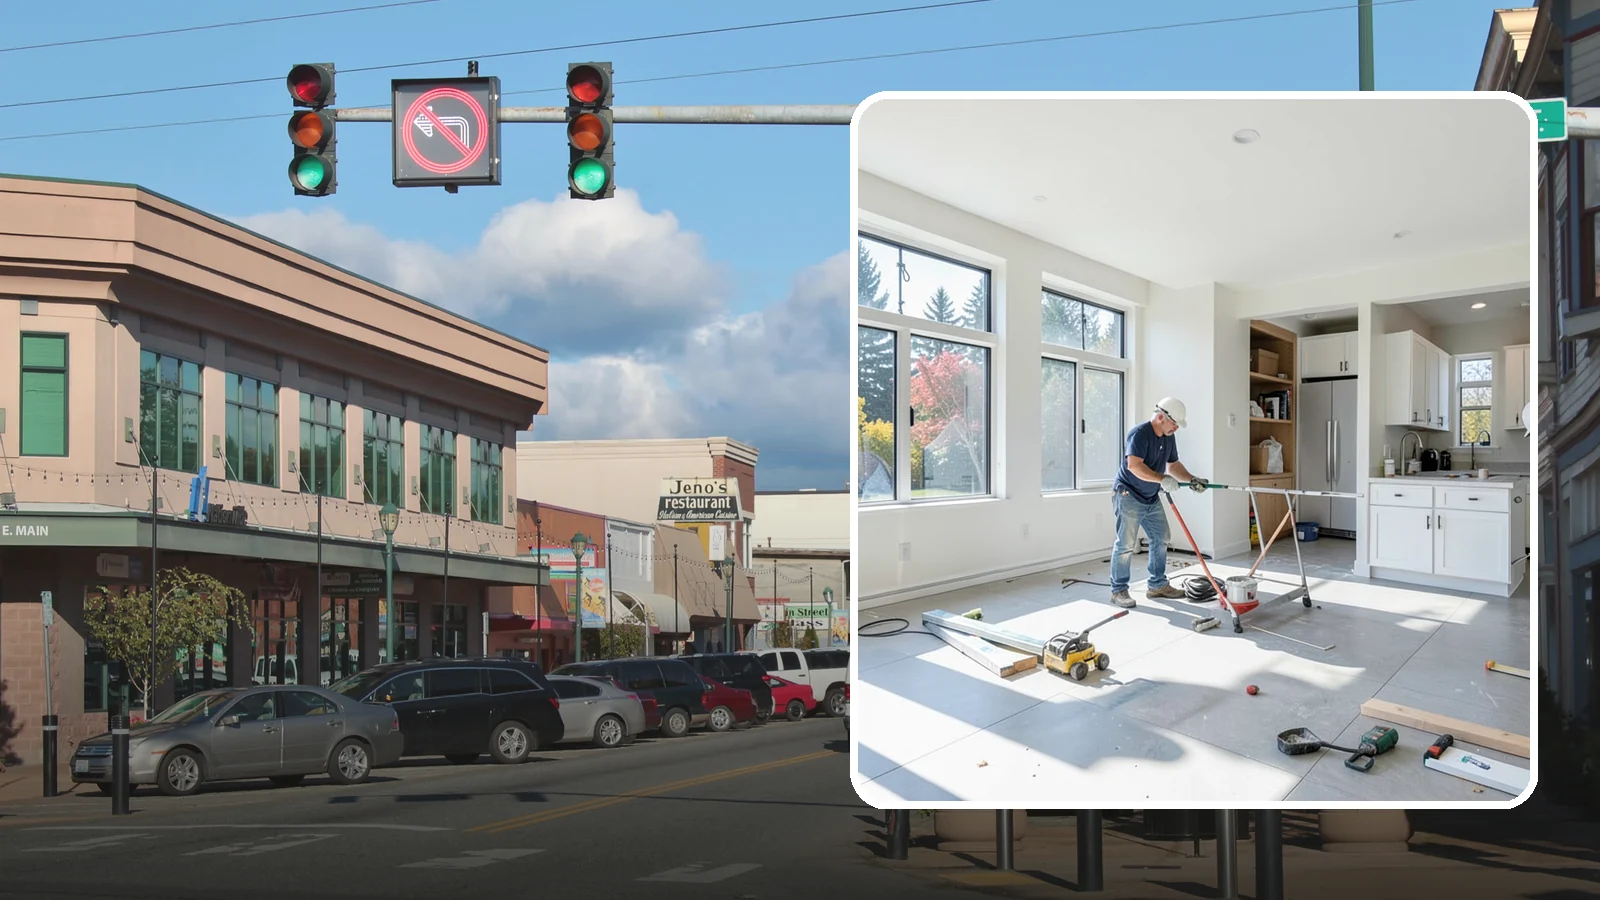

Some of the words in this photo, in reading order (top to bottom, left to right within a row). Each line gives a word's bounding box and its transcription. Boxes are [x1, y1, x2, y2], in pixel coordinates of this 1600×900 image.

[669, 480, 727, 494] Jeno's
[665, 496, 731, 509] restaurant
[659, 510, 682, 519] Italian
[686, 510, 714, 519] American
[715, 510, 738, 519] Cuisine
[2, 525, 13, 536] E.
[15, 525, 49, 536] MAIN
[797, 607, 828, 617] Street
[790, 619, 824, 627] lass
